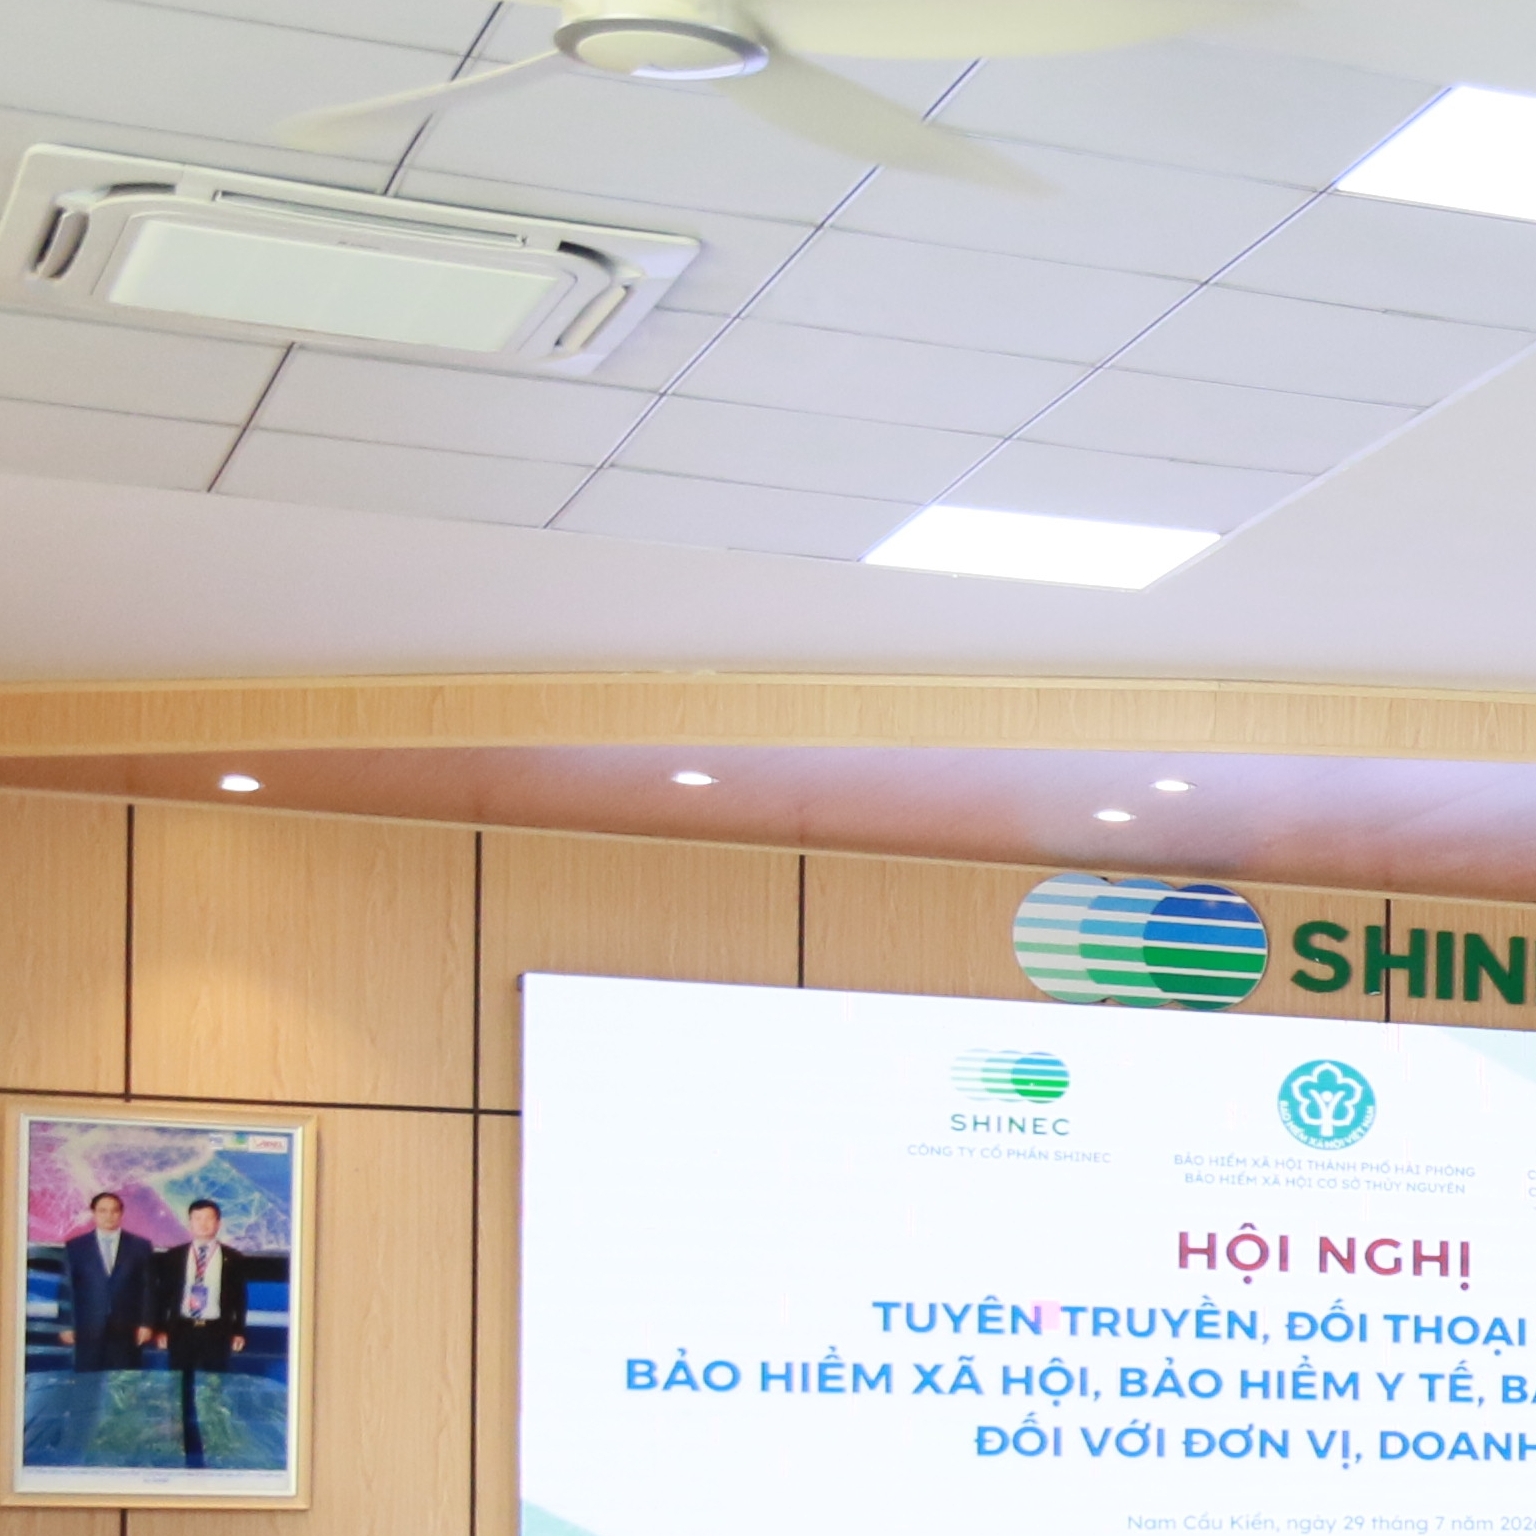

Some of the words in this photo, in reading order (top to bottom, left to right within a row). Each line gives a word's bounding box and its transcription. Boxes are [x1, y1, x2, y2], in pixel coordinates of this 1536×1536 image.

[950, 1113, 1070, 1137] SHINEC
[906, 1142, 953, 1158] CÔNG
[957, 1145, 976, 1158] TY
[1053, 1149, 1112, 1164] SHINEC
[1274, 1156, 1303, 1172] HỘI
[1284, 1174, 1313, 1190] HỘI
[1405, 1181, 1466, 1195] NGUYÊN
[1178, 1222, 1289, 1285] HỘI
[1318, 1235, 1470, 1292] NGHỊ
[871, 1294, 1042, 1336] TUYÊN
[1060, 1294, 1270, 1345] TRUYỀN,
[1382, 1313, 1527, 1356] THOẠI
[626, 1347, 742, 1393] BẢO
[760, 1345, 893, 1394] HIỂM
[912, 1355, 984, 1396] XÃ
[1001, 1356, 1102, 1408] HỘI,
[1119, 1356, 1224, 1400] BẢO
[1240, 1354, 1360, 1401] HIỂM
[1376, 1372, 1405, 1402] Y
[1418, 1359, 1485, 1407] TẾ,
[973, 1411, 1062, 1458] ĐỐI
[1080, 1418, 1166, 1459] VỚI
[1181, 1423, 1290, 1459] ĐƠN
[1305, 1429, 1363, 1470] VỊ,
[1127, 1515, 1177, 1531] Nam
[1286, 1514, 1338, 1535] ngày
[1343, 1515, 1366, 1531] 29
[1370, 1515, 1429, 1536] tháng
[1435, 1515, 1446, 1531] 7
[1451, 1515, 1494, 1531] năm
